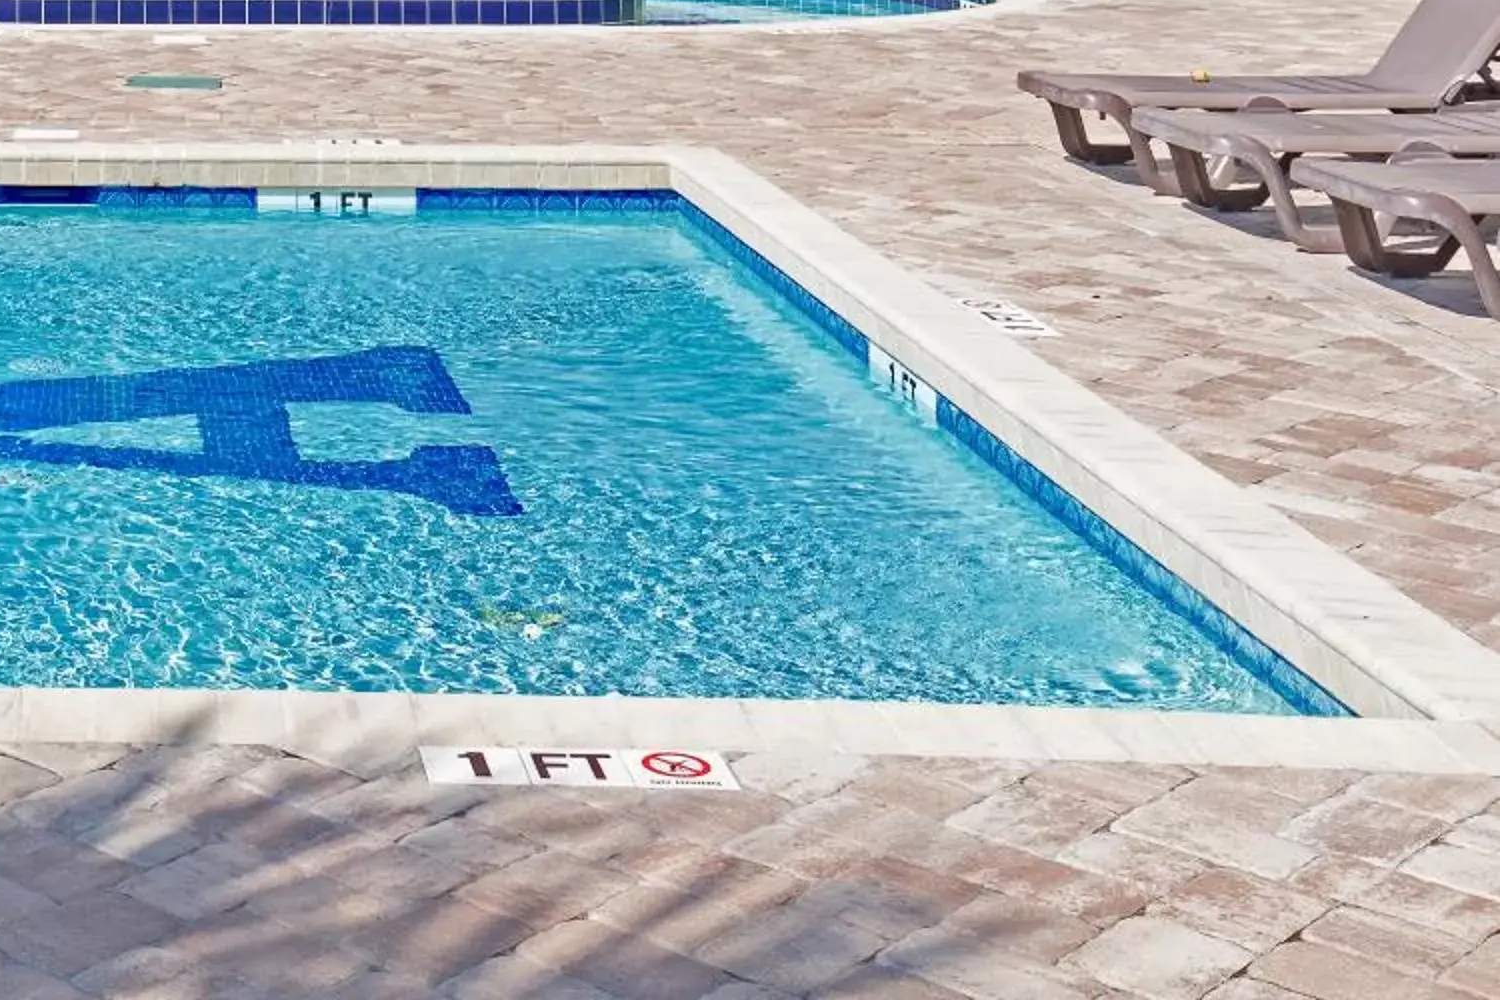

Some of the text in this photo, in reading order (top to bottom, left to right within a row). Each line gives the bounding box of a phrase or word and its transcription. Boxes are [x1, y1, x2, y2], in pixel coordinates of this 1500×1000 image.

[309, 191, 373, 216] 1 FT
[889, 362, 917, 403] 1 FT
[457, 751, 612, 780] 1 FT
